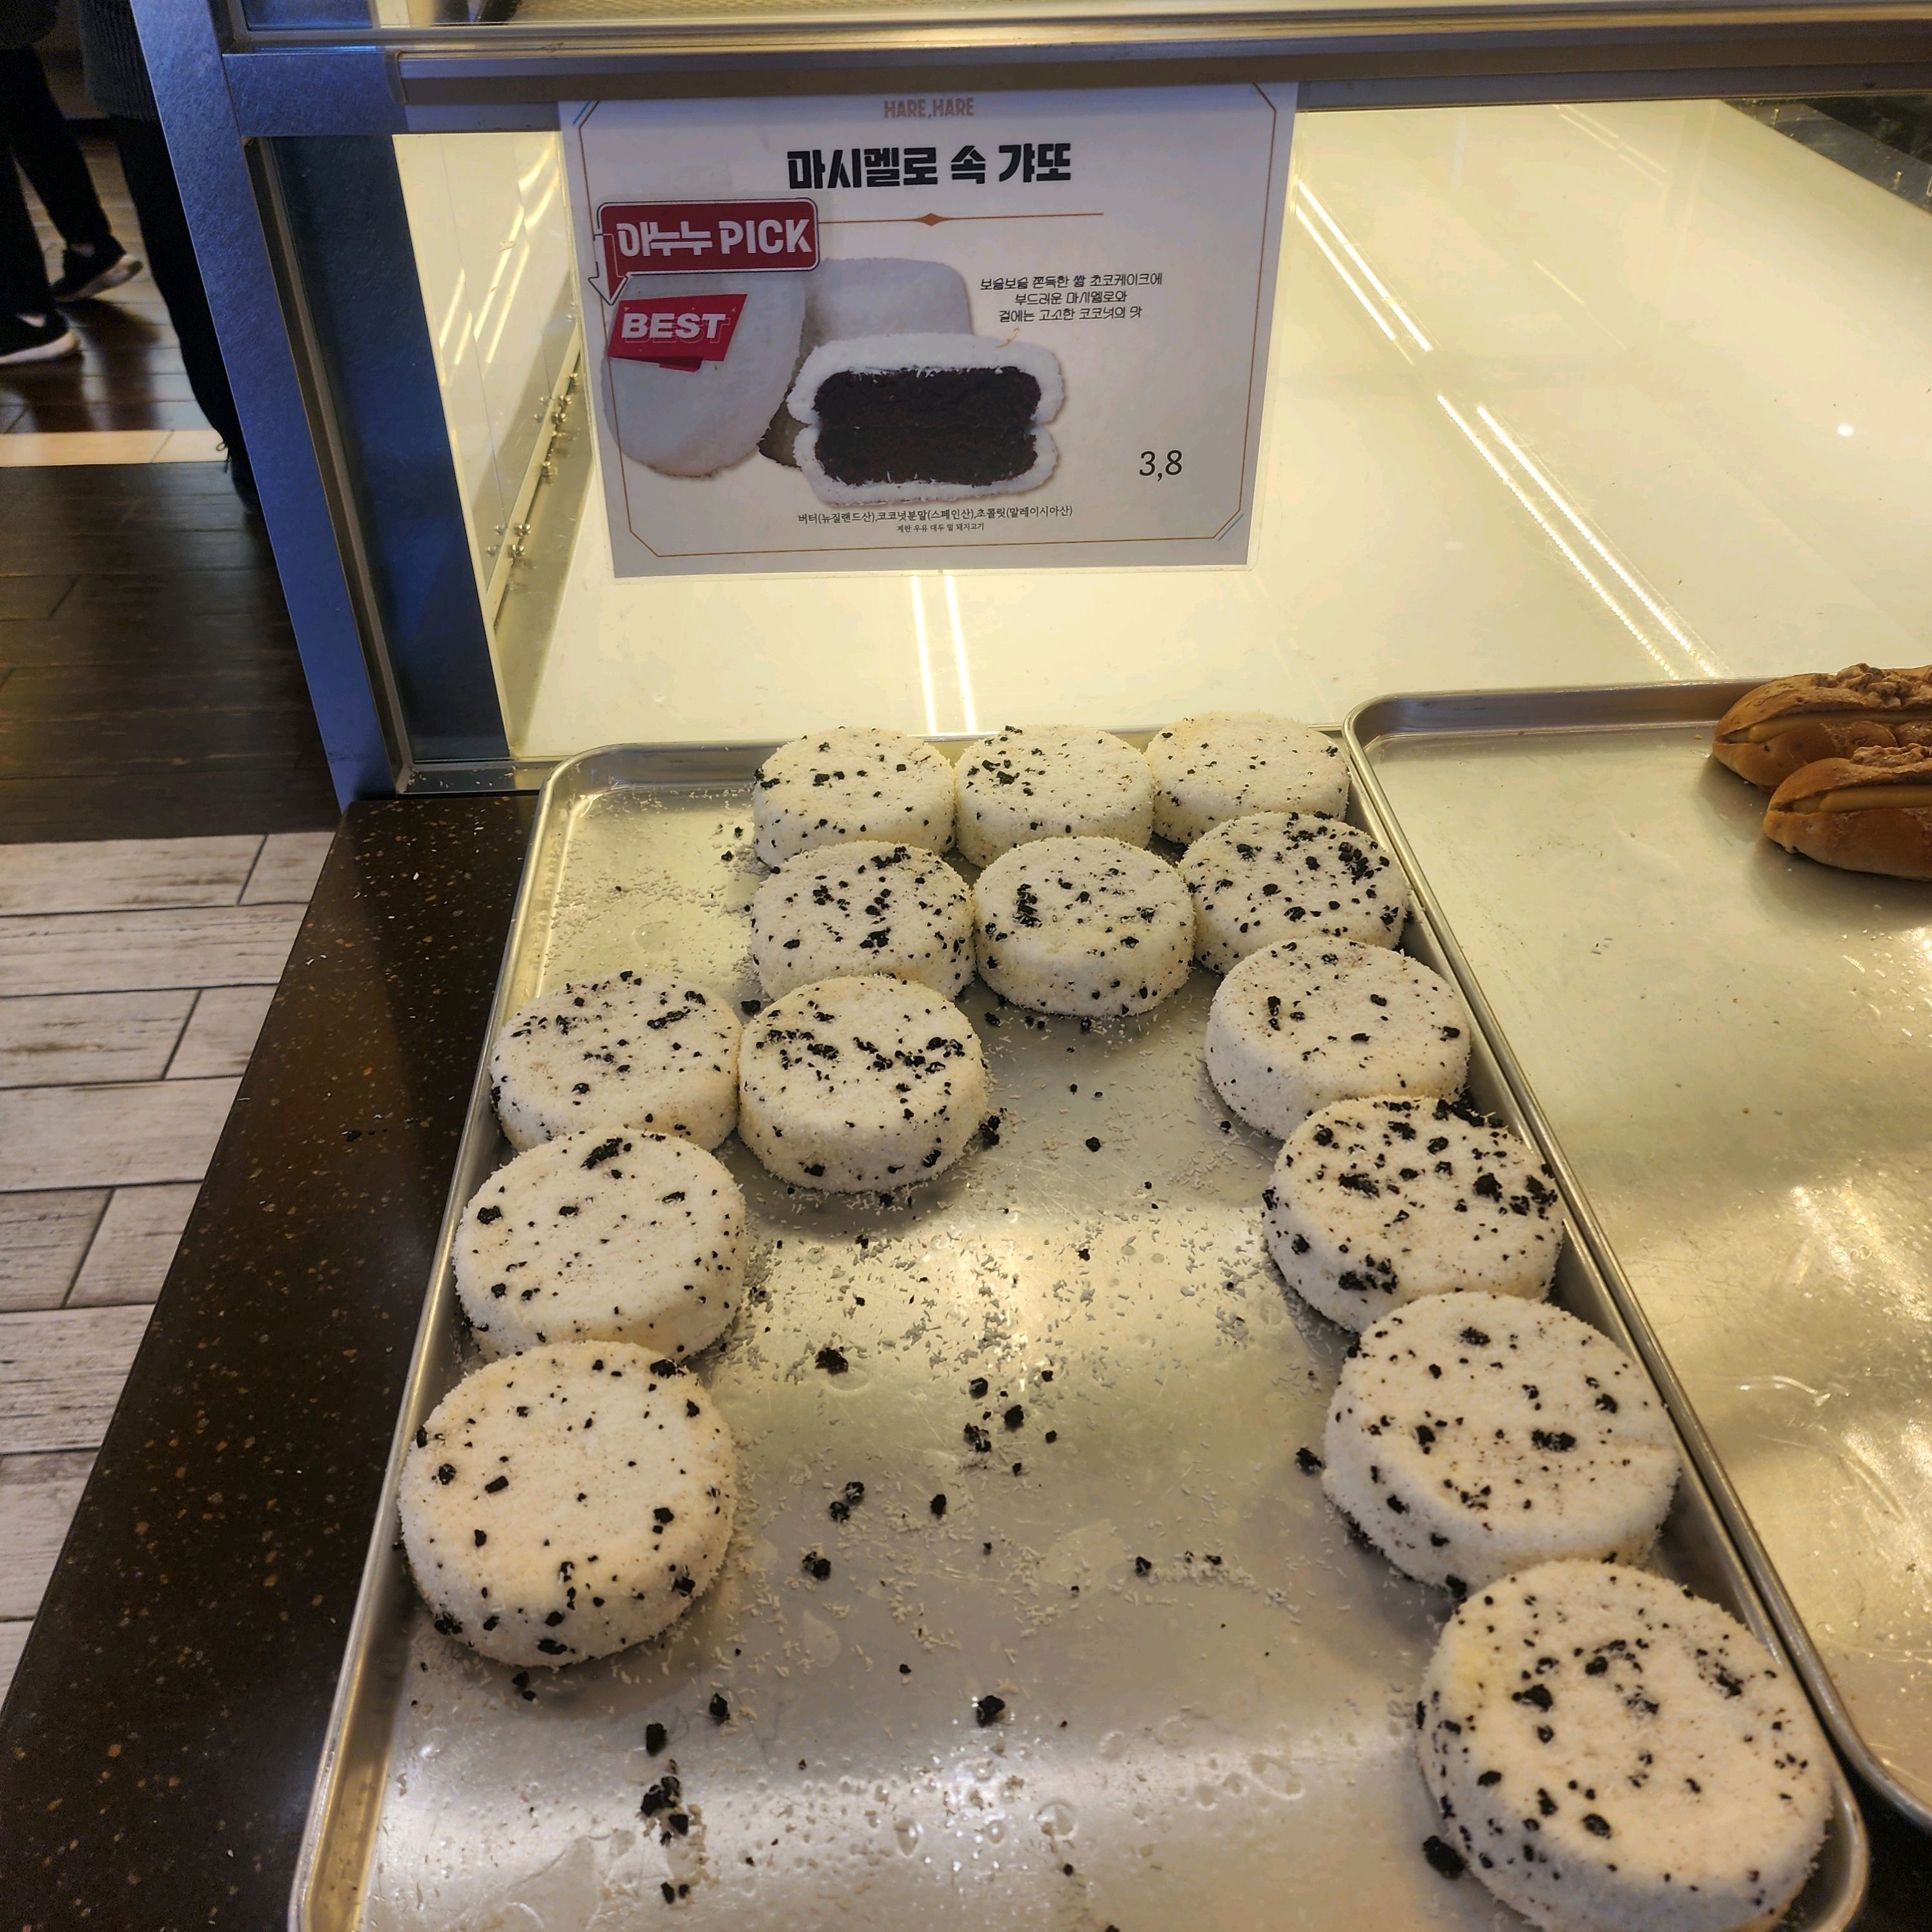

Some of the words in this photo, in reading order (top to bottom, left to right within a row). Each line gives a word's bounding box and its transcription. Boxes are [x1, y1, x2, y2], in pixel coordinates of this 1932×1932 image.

[787, 147, 938, 189] 마시멜로
[951, 145, 986, 184] 속
[718, 219, 812, 254] PICK
[1033, 275, 1069, 289] 쫀득한
[1073, 275, 1086, 287] 쌀
[1090, 272, 1163, 287] 초코케이크에
[1014, 293, 1063, 306] 부드러운
[1066, 290, 1128, 304] 마시멜로와
[1038, 308, 1075, 322] 고소한
[1079, 307, 1125, 320] 코코넛의
[1130, 305, 1143, 318] 맛
[621, 313, 727, 339] BEST
[1139, 449, 1182, 482] 3,8
[930, 524, 944, 532] 대두
[956, 522, 985, 531] 돼지고기
